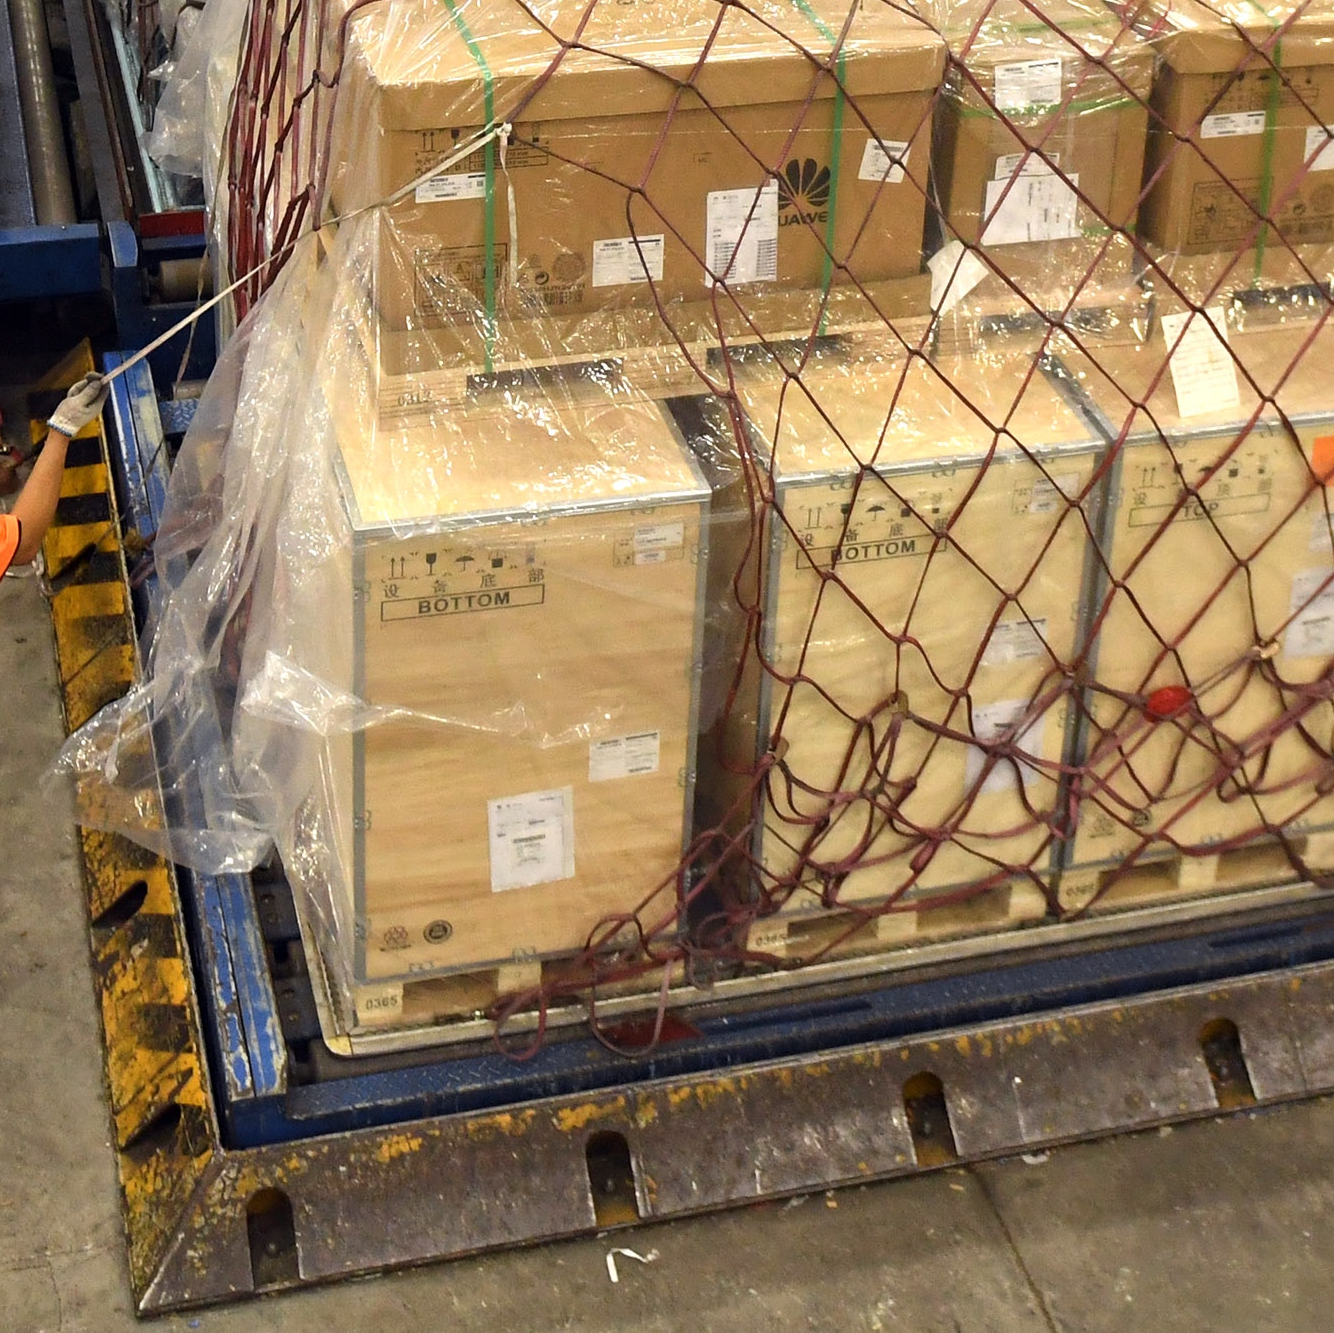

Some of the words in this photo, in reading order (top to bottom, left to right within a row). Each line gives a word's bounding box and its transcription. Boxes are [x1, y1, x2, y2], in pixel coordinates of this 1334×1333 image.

[831, 539, 916, 561] BOTTOM
[383, 568, 545, 598] 设备底部
[418, 592, 511, 614] BOTTOM
[365, 994, 398, 1010] 0365
